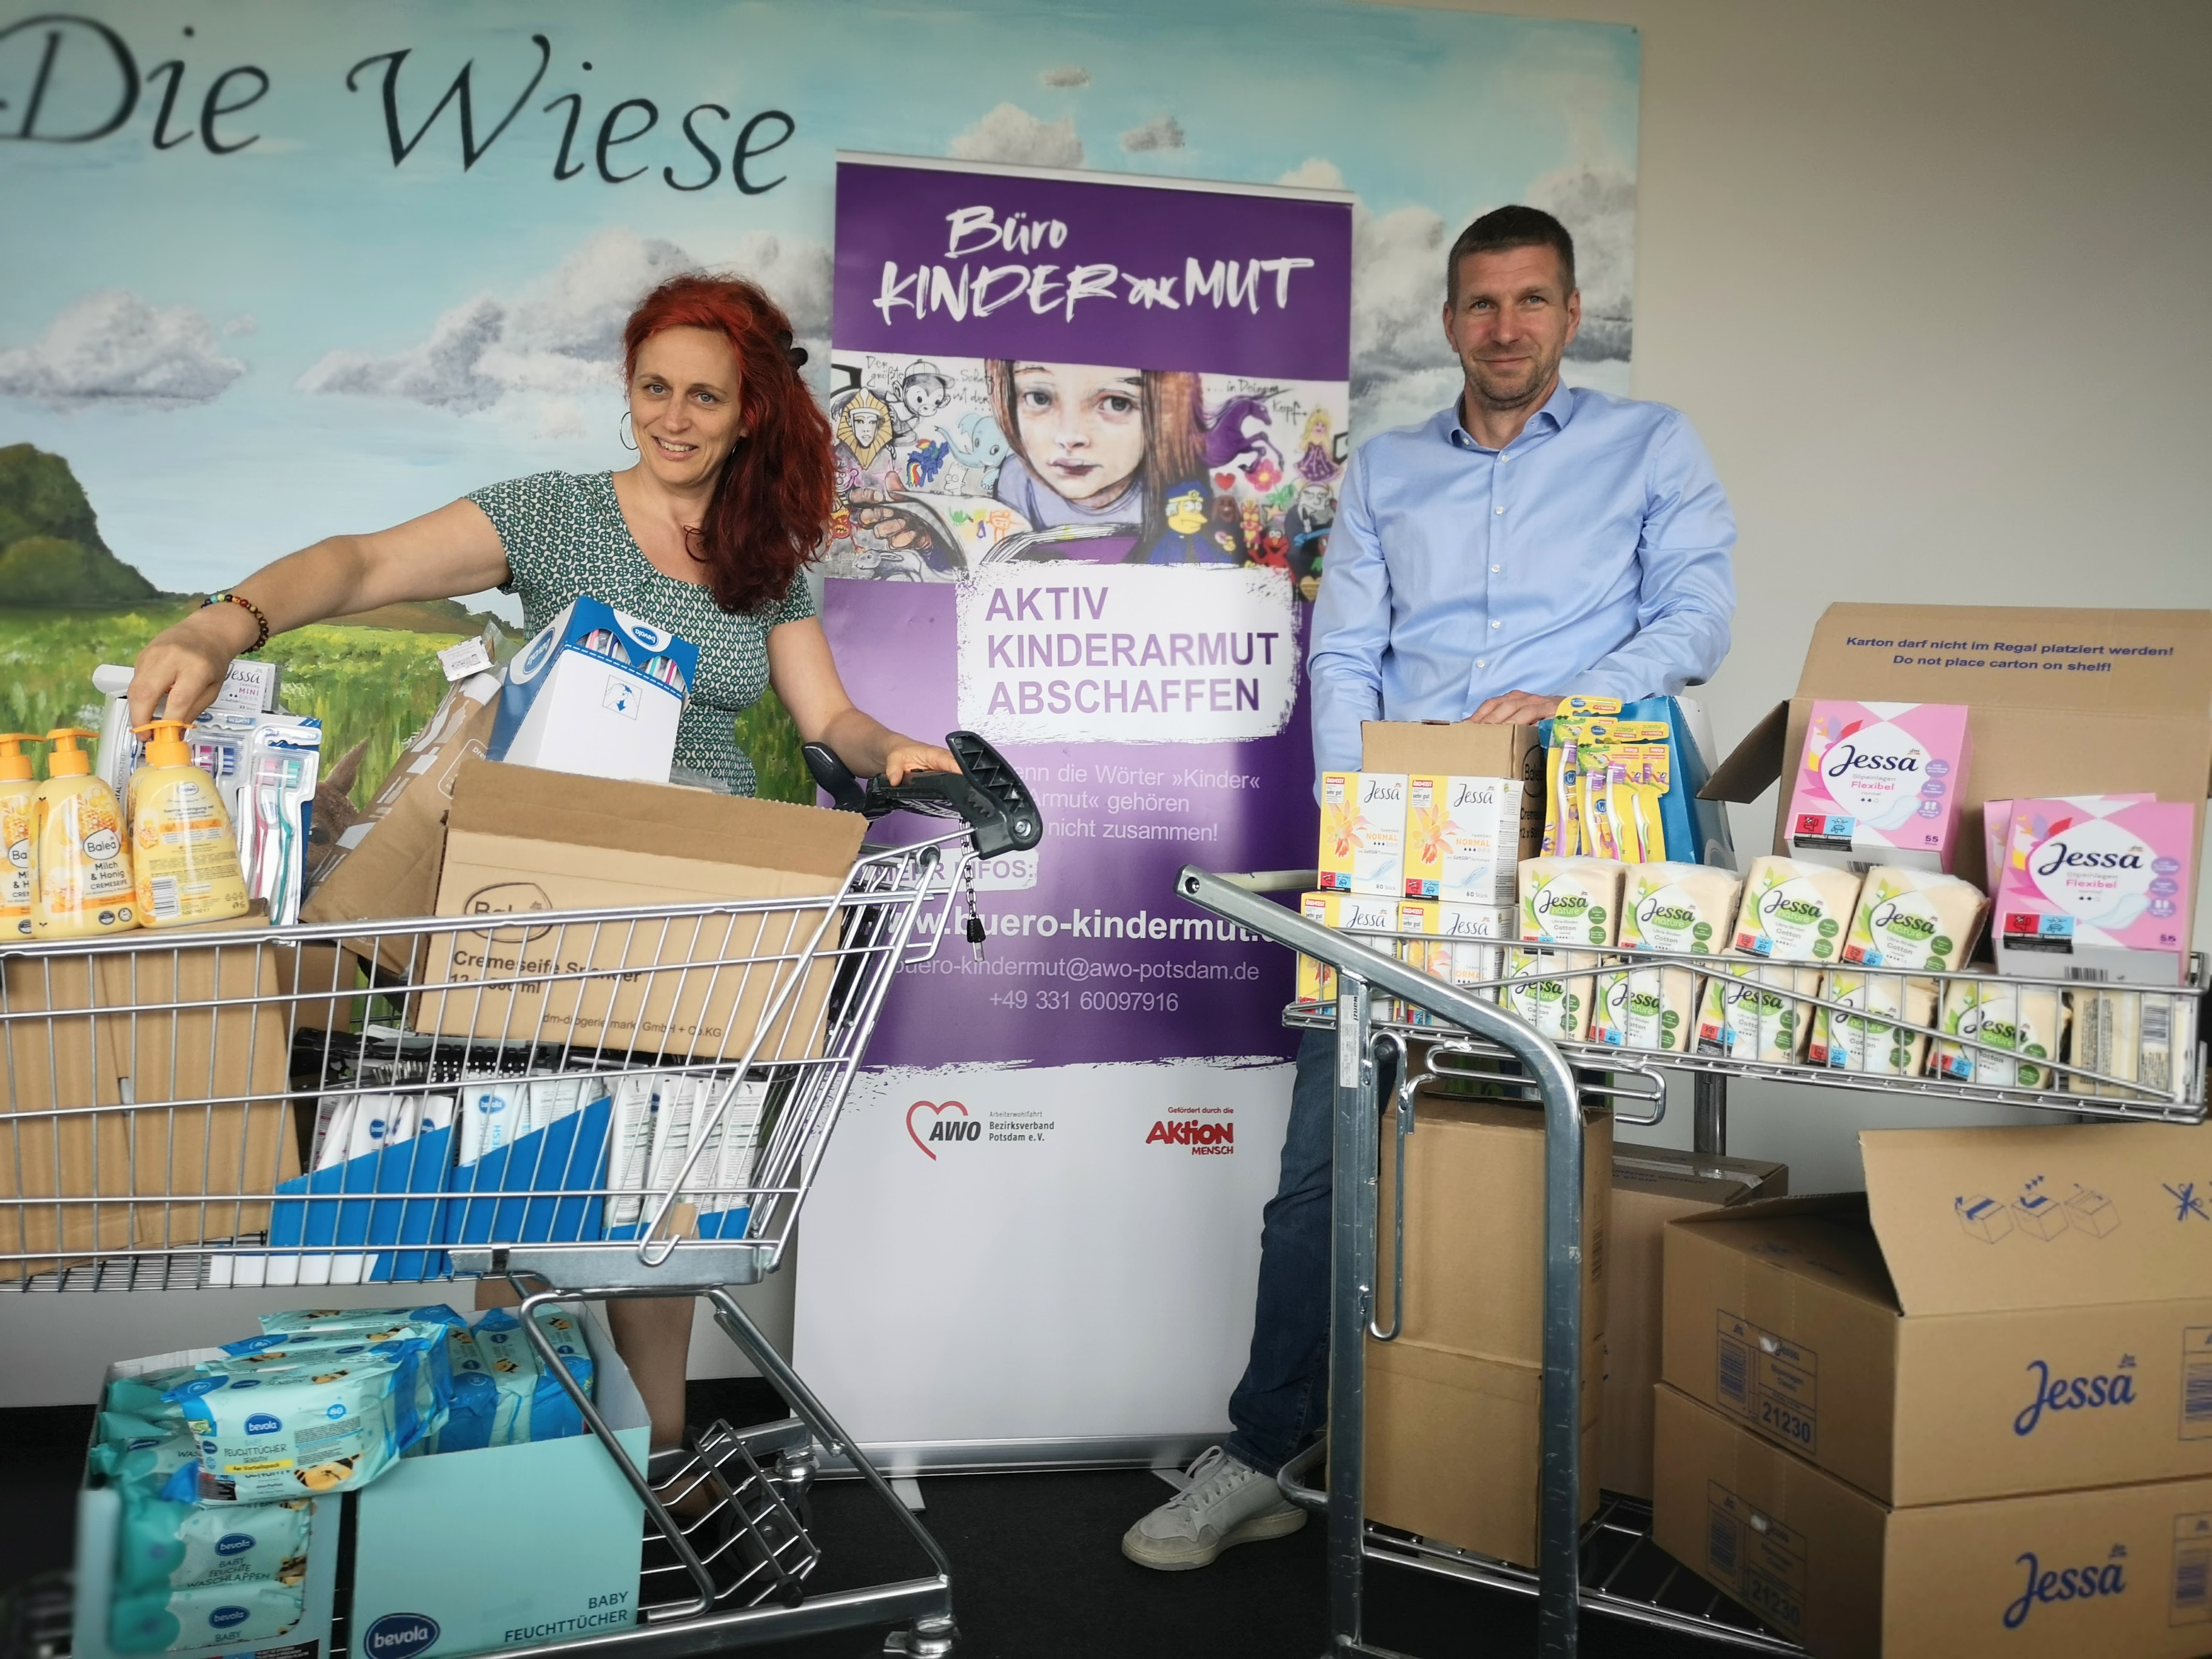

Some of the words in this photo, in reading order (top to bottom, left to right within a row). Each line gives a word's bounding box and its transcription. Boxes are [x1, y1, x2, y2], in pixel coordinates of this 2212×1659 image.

[0, 13, 269, 155] Die
[346, 34, 795, 195] Wiese
[944, 205, 1068, 258] Büro
[865, 355, 889, 369] Der
[866, 366, 904, 387] größte
[985, 586, 1108, 621] AKTIV
[634, 628, 657, 643] bevola
[988, 632, 1279, 668] KINDERARMUT
[1846, 637, 1894, 647] Karton
[1897, 639, 1928, 648] darf
[1930, 640, 1968, 650] nicht
[1971, 641, 1989, 651] im
[1994, 642, 2037, 654] Regal
[2040, 644, 2105, 654] platziert
[2108, 646, 2174, 656] werden!
[1893, 655, 1913, 664] Do
[1917, 657, 1942, 666] not
[1945, 657, 1985, 668] place
[1989, 660, 2038, 669] carton
[2067, 662, 2111, 672] shelf!
[224, 663, 260, 683] Jessa
[239, 688, 259, 696] MINI
[987, 678, 1259, 715] ABSCHAFFEN
[1828, 745, 1919, 777] Jessa
[1011, 765, 1050, 782] enn
[1057, 763, 1088, 783] die
[1095, 765, 1165, 787] Wörter
[1172, 769, 1261, 789] »Kinder«
[1364, 780, 1400, 803] Jessa
[1851, 781, 1895, 791] Flexibel
[1107, 793, 1190, 814] gehören
[1453, 783, 1493, 807] Jessa
[1048, 819, 1096, 838] nicht
[1103, 823, 1218, 842] zusammen!
[87, 841, 116, 853] Balea
[1456, 838, 1491, 847] NORMAL
[95, 861, 118, 871] Milch
[2037, 842, 2143, 876] Jessa
[100, 870, 125, 880] Honig
[2066, 871, 2118, 880] Slipeinlagen
[90, 879, 127, 890] CREMESEIFE
[2066, 880, 2117, 888] Flexibel
[1539, 890, 1589, 914] Jessa
[1641, 898, 1696, 922] Jessa
[1764, 890, 1822, 917] Jessa
[887, 907, 1274, 942] ww.buero-kindermut.
[1346, 905, 1386, 928] Jessa
[1446, 913, 1489, 936] Jessa
[1655, 918, 1684, 928] nature
[1778, 910, 1810, 923] nature
[1875, 903, 1936, 934] Jessa
[1654, 934, 1678, 943] Cotton
[1776, 928, 1801, 939] Cotton
[1889, 925, 1923, 939] nature
[1887, 942, 1913, 954] Cotton
[454, 950, 560, 974] Cremeseife
[990, 990, 1028, 1010] +49
[1036, 991, 1070, 1010] 331
[1080, 991, 1179, 1011] 60097916
[1630, 1004, 1654, 1014] ature
[543, 1014, 605, 1028] dm-dogerie
[609, 1020, 637, 1030] mark
[642, 1022, 676, 1033] GmbH
[1851, 1019, 1884, 1031] naure
[1849, 1038, 1876, 1048] Coton
[1980, 1031, 2014, 1047] nature
[928, 1121, 982, 1141] AWO
[989, 1121, 1054, 1130] Bezirksverband
[989, 1133, 1025, 1142] Potsdam
[1191, 1145, 1234, 1155] MENSCH
[2014, 1359, 2137, 1436] Jessa
[249, 1421, 278, 1431] bevola
[1763, 1401, 1811, 1443] 21230
[223, 1444, 287, 1457] FEUCHTTÜCHER
[220, 1540, 250, 1551] bevola
[209, 1564, 252, 1577] FEUCHTE
[219, 1557, 246, 1568] BABY
[187, 1573, 270, 1587] WASCHLAPPEN
[2003, 1552, 2127, 1629] Jessa
[588, 1591, 629, 1609] BABY
[1753, 1578, 1800, 1627] 21230
[213, 1610, 244, 1622] bevola
[504, 1609, 628, 1643] FEUCHTTÜCHER
[215, 1631, 242, 1642] BABY
[374, 1625, 429, 1649] bevola
